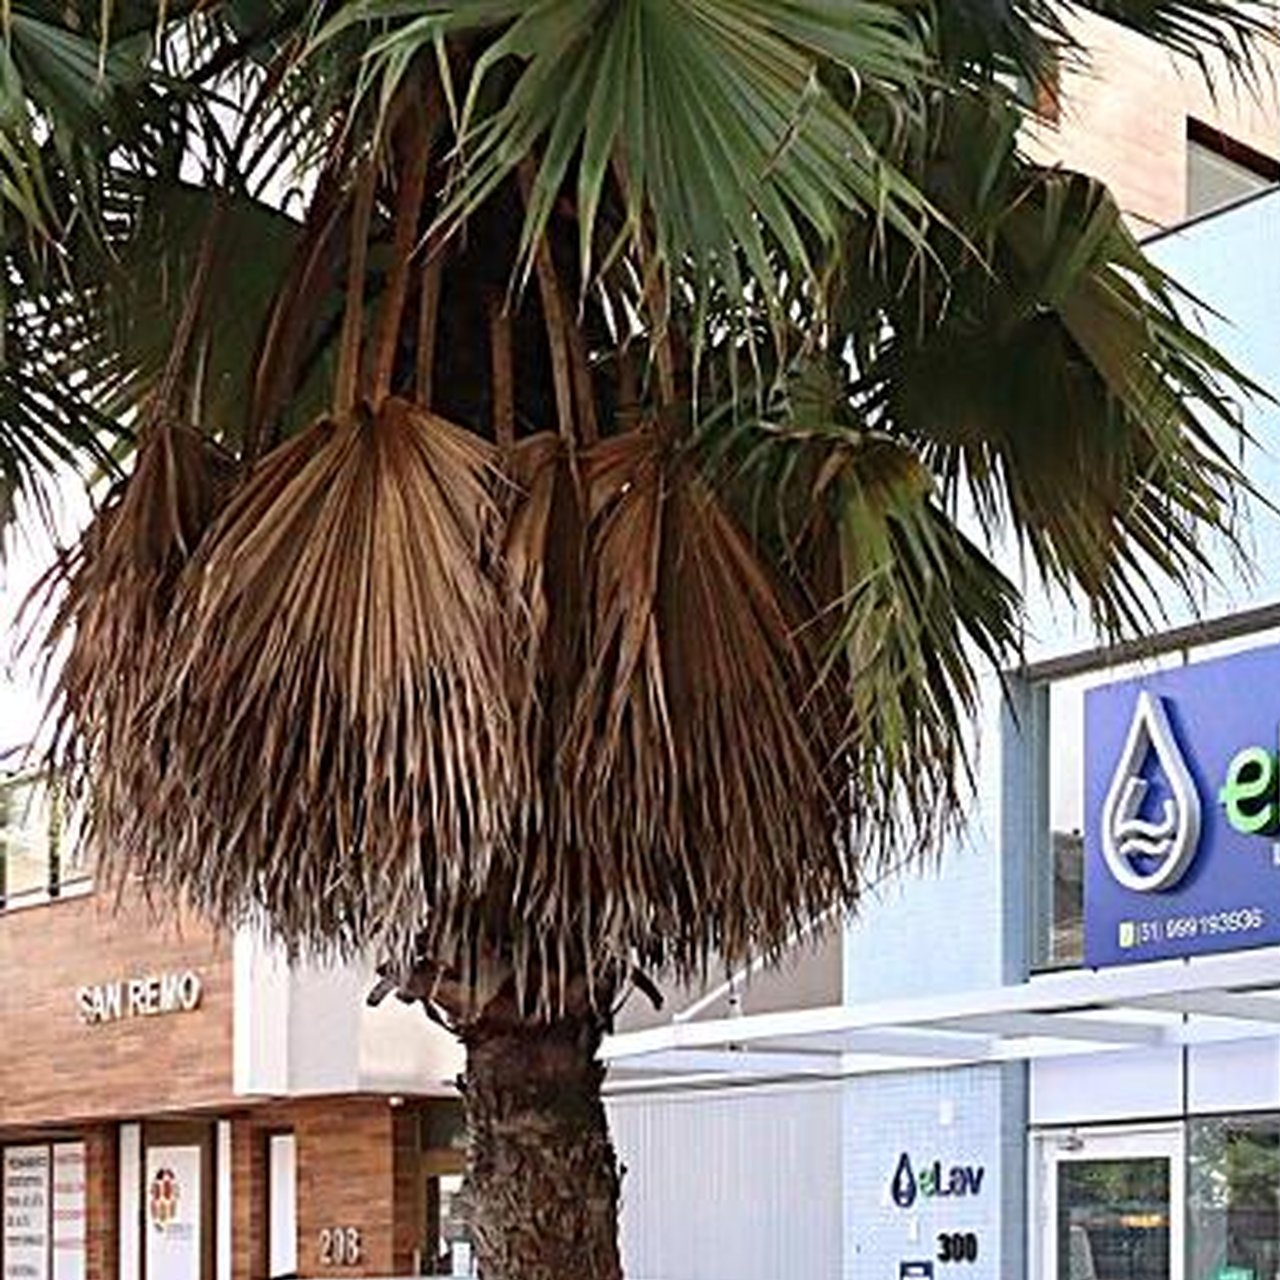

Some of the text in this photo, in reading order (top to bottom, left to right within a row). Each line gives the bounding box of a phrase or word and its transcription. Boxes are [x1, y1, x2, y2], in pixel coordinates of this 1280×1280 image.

[77, 970, 201, 1021] SAN REMO
[919, 1160, 985, 1197] eLav
[936, 1232, 978, 1263] 300
